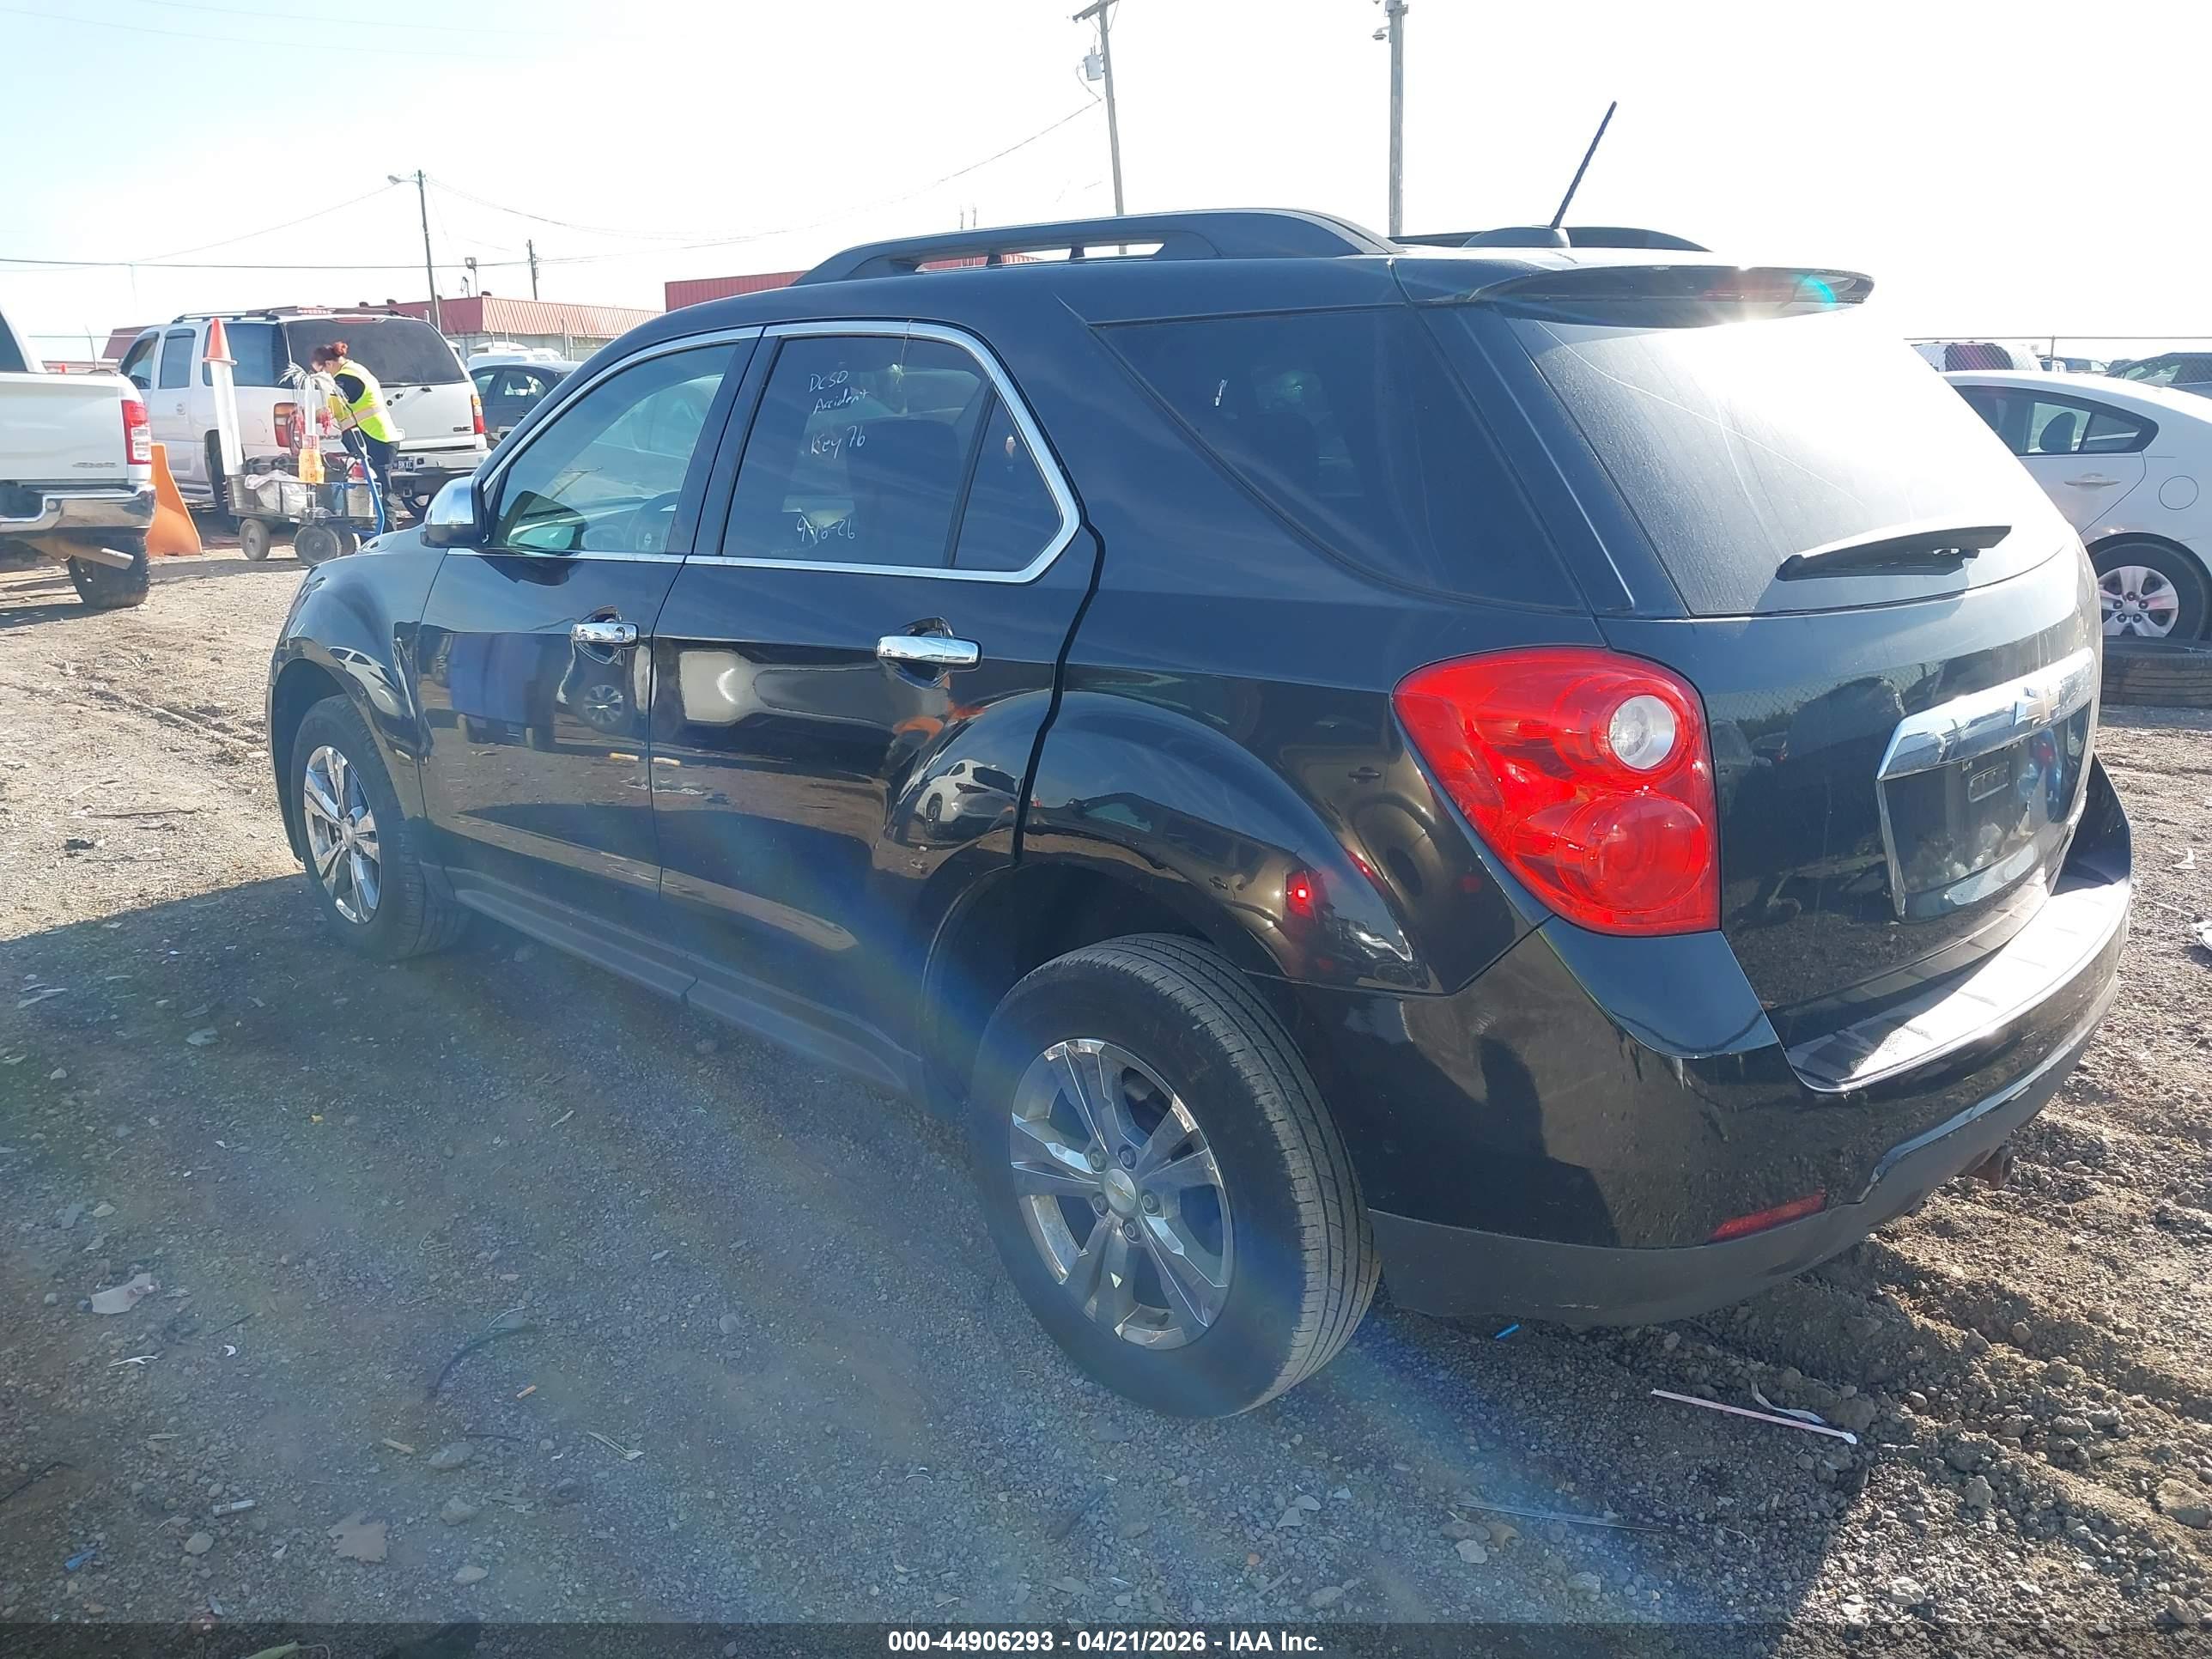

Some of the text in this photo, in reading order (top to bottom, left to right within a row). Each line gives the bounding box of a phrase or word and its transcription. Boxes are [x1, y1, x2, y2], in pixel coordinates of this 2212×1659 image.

[809, 370, 848, 392] DCSO
[812, 387, 871, 415] Accident
[811, 425, 866, 459] Key 76
